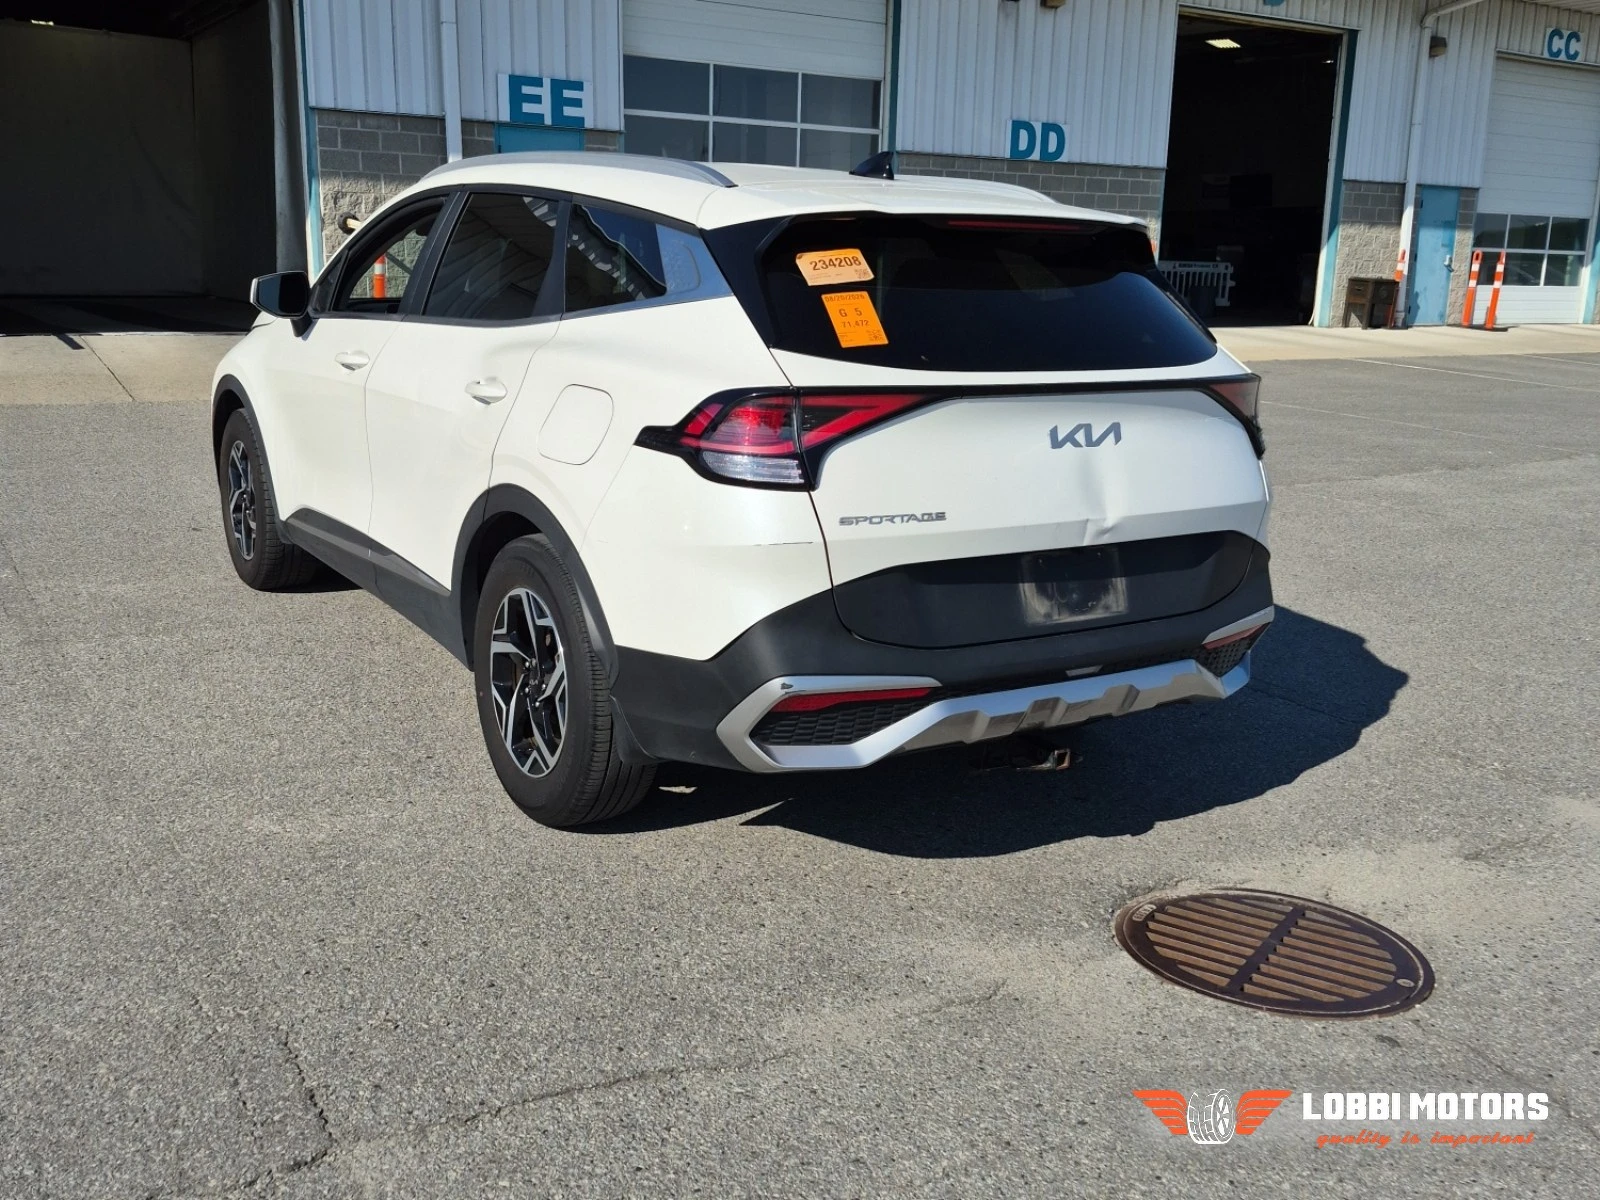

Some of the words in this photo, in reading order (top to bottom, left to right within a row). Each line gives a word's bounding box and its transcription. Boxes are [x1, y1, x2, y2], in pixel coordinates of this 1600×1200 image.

[1547, 28, 1581, 61] CC
[508, 74, 586, 128] EE
[1009, 119, 1066, 161] DD
[809, 255, 862, 271] 234208
[1049, 422, 1121, 449] KIA
[839, 512, 947, 526] SPORTAGE
